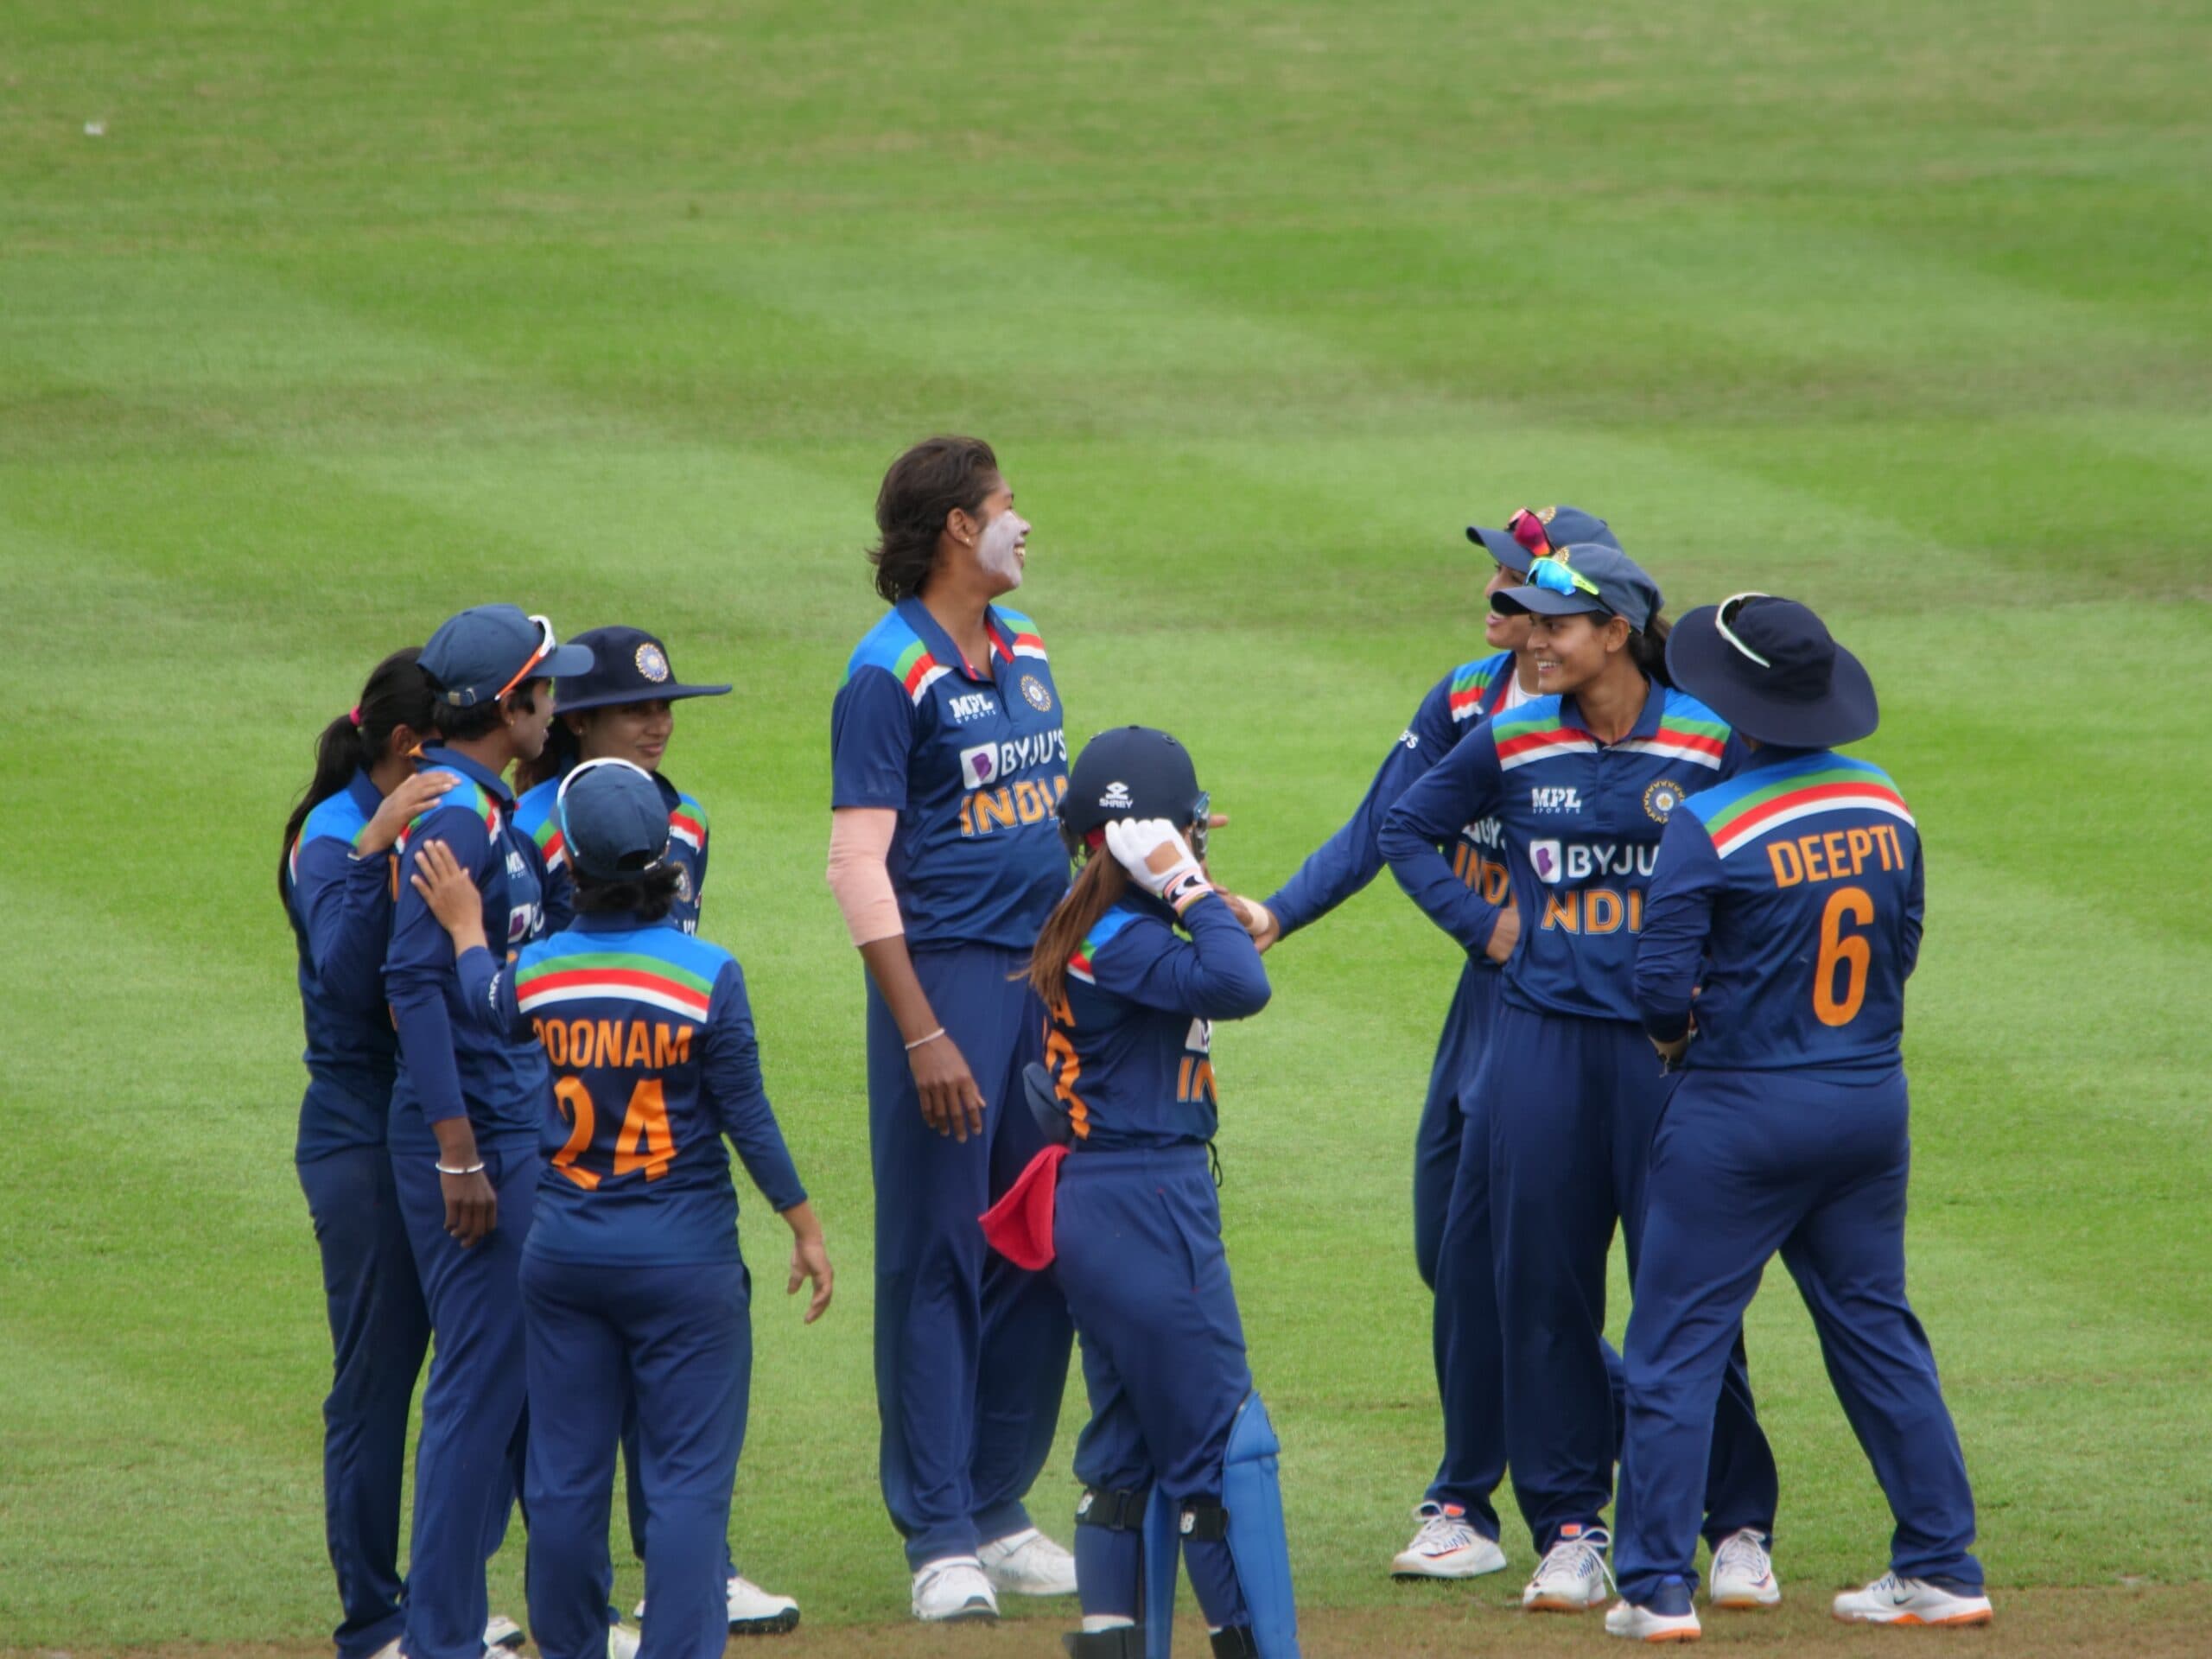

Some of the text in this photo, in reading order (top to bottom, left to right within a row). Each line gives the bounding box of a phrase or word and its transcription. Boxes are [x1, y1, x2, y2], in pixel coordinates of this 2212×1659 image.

[949, 693, 994, 719] MPL
[1001, 729, 1067, 777] BYJU'S
[1532, 788, 1582, 808] MPL
[1766, 823, 1904, 889] DEEPTI
[1812, 886, 1875, 1027] 6
[551, 1075, 677, 1191] 24
